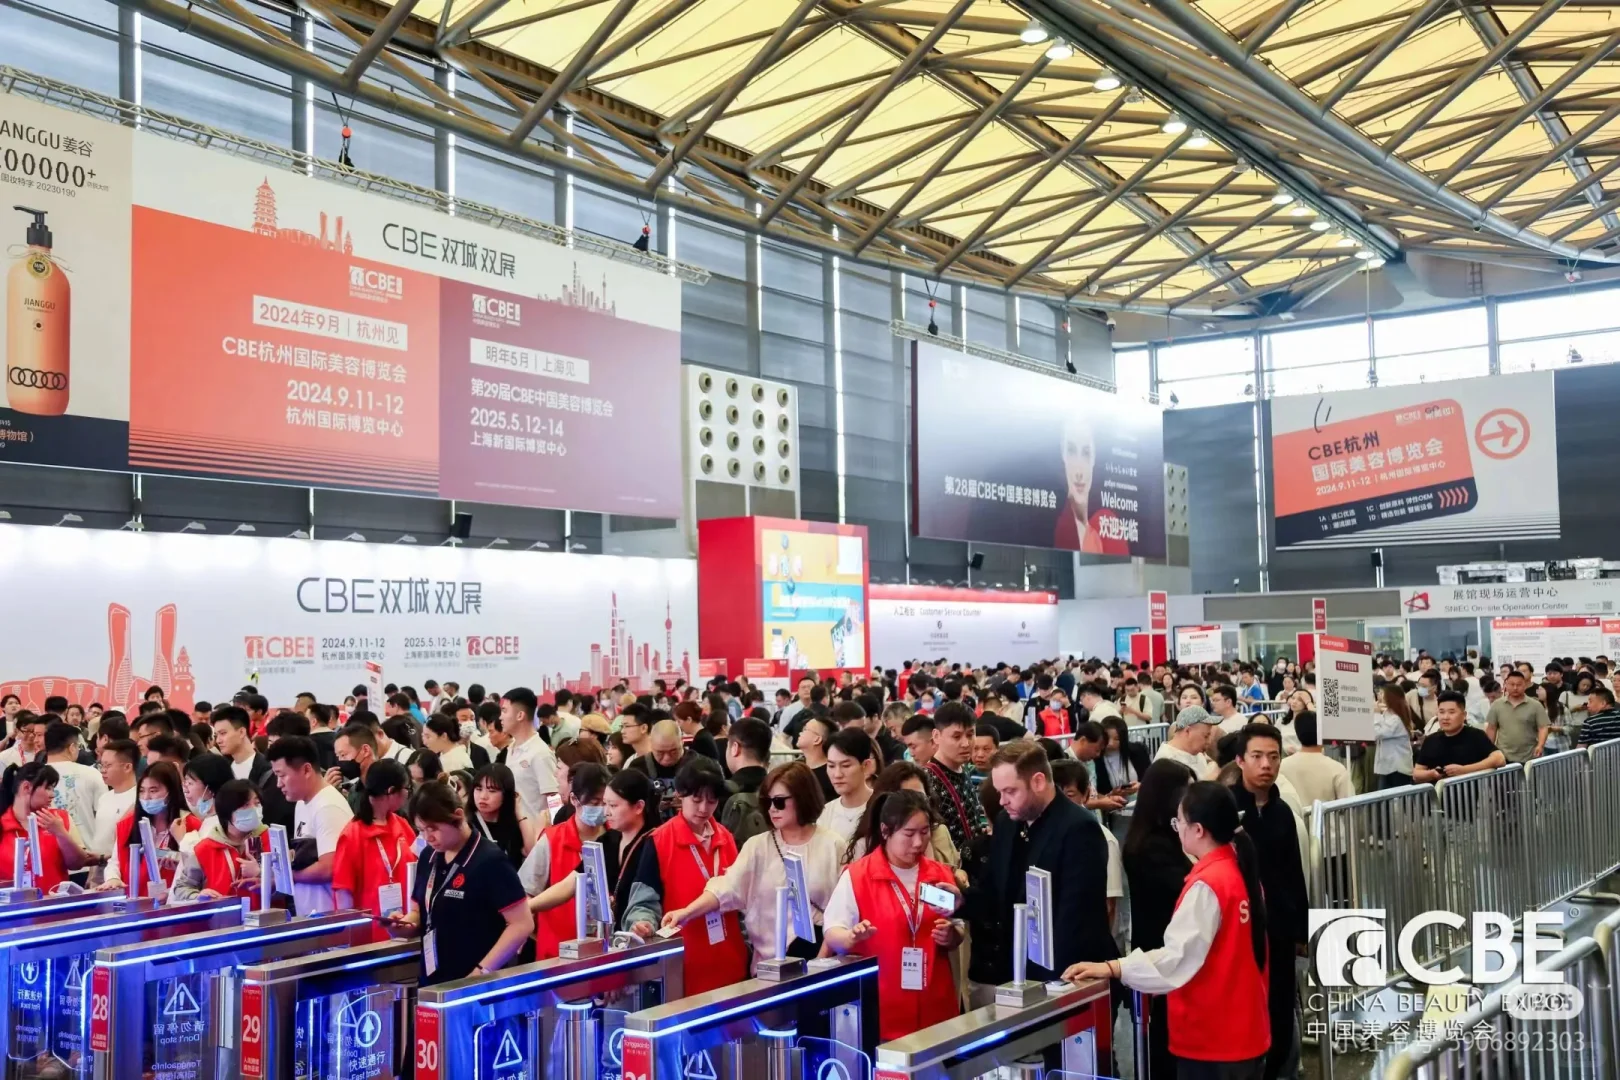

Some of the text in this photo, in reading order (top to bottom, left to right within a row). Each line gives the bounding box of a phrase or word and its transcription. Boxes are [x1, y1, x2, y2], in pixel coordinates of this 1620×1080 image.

[0, 147, 96, 187] 00000+
[36, 181, 76, 197] 20230190
[382, 222, 516, 279] CBE双城双展
[24, 297, 56, 310] JIANGGU
[222, 336, 407, 384] CBE杭州国际美容博览会
[287, 380, 404, 415] 2024.9.11-12
[471, 378, 614, 418] 第29届CBE中国美容博览会
[286, 405, 404, 437] 杭州国际博览中心
[471, 407, 564, 437] 2025.5.12-14
[471, 431, 567, 457] 上海新国际博览中心
[1308, 431, 1380, 460] CBE杭州
[1311, 438, 1443, 482] 国际美容博览会
[944, 475, 1056, 509] 第28届CBE中国美容博览会
[1316, 459, 1446, 496] 2024.9.11-12 杭州国际博览中心
[1100, 491, 1138, 512] Welcome
[1099, 514, 1138, 542] 欢迎光临
[296, 577, 482, 614] CBE双城双展
[1453, 586, 1558, 600] 展馆现场运营中心
[1502, 603, 1540, 612] Operation
[1542, 602, 1568, 610] Center
[322, 637, 385, 649] 2024.9.11-12
[322, 651, 385, 661] 杭州国际博览中心
[404, 637, 461, 649] 2025.5.12-14
[92, 993, 108, 1020] 28
[242, 1014, 261, 1043] 29
[348, 1050, 386, 1072] 快速通行
[417, 1038, 438, 1070] 30
